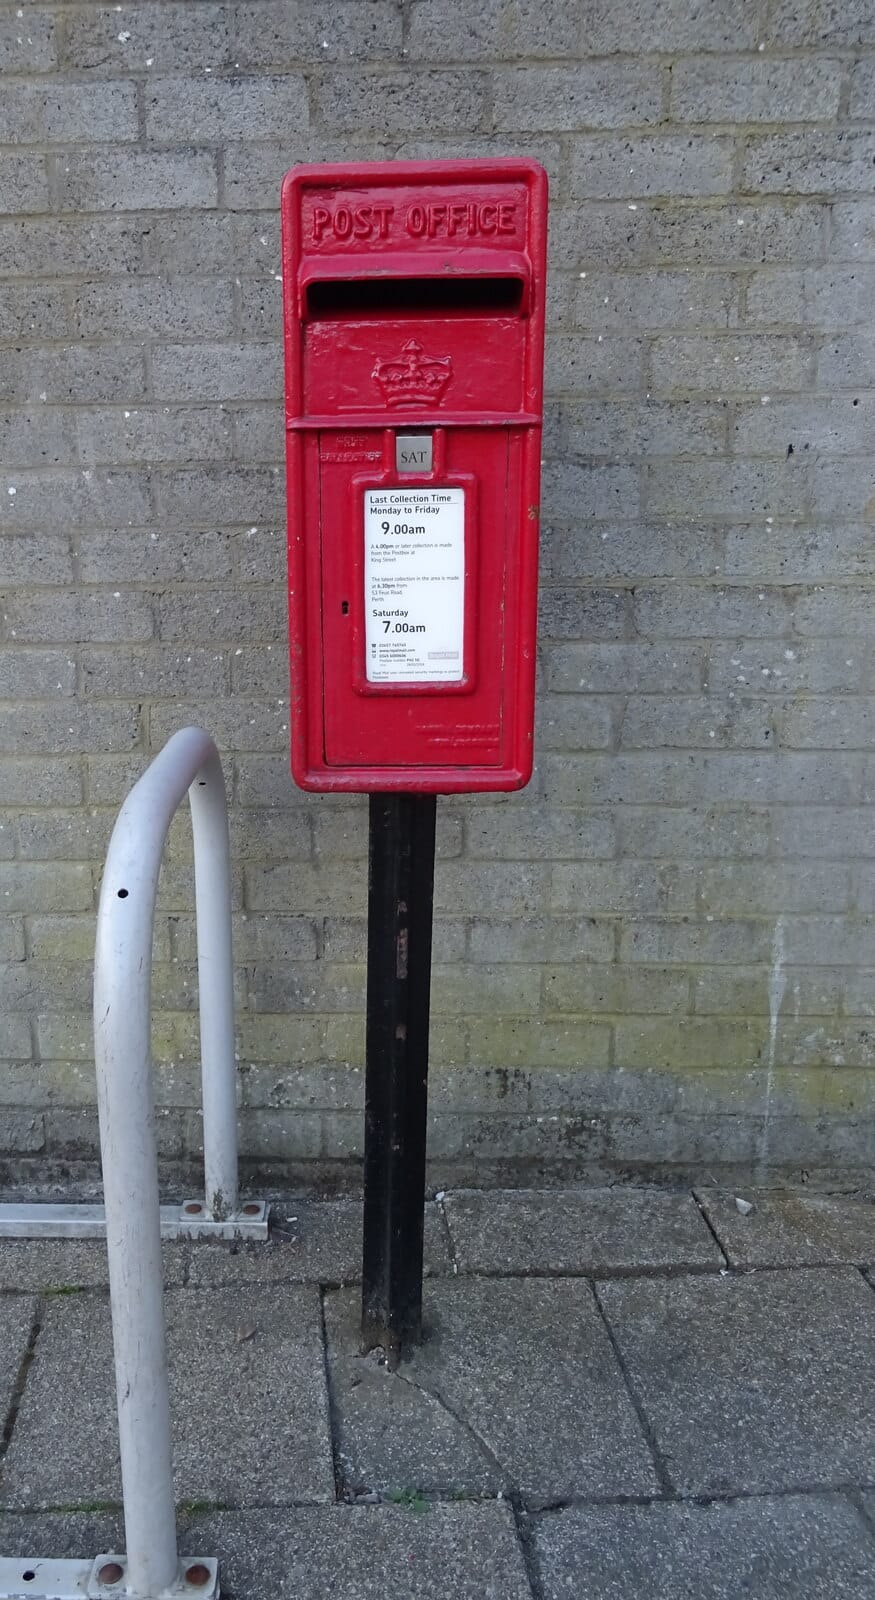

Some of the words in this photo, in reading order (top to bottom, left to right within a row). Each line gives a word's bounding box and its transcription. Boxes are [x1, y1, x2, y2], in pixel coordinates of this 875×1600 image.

[312, 206, 394, 241] POST
[405, 203, 517, 237] OFFICE
[400, 451, 427, 464] SAT
[370, 496, 387, 504] Last
[390, 495, 429, 503] Collection
[431, 494, 452, 502] Time
[370, 507, 401, 516] Monday
[415, 506, 440, 514] Friday
[381, 522, 426, 535] 9.00am
[372, 609, 408, 617] Saturday
[382, 620, 426, 634] 7.00am
